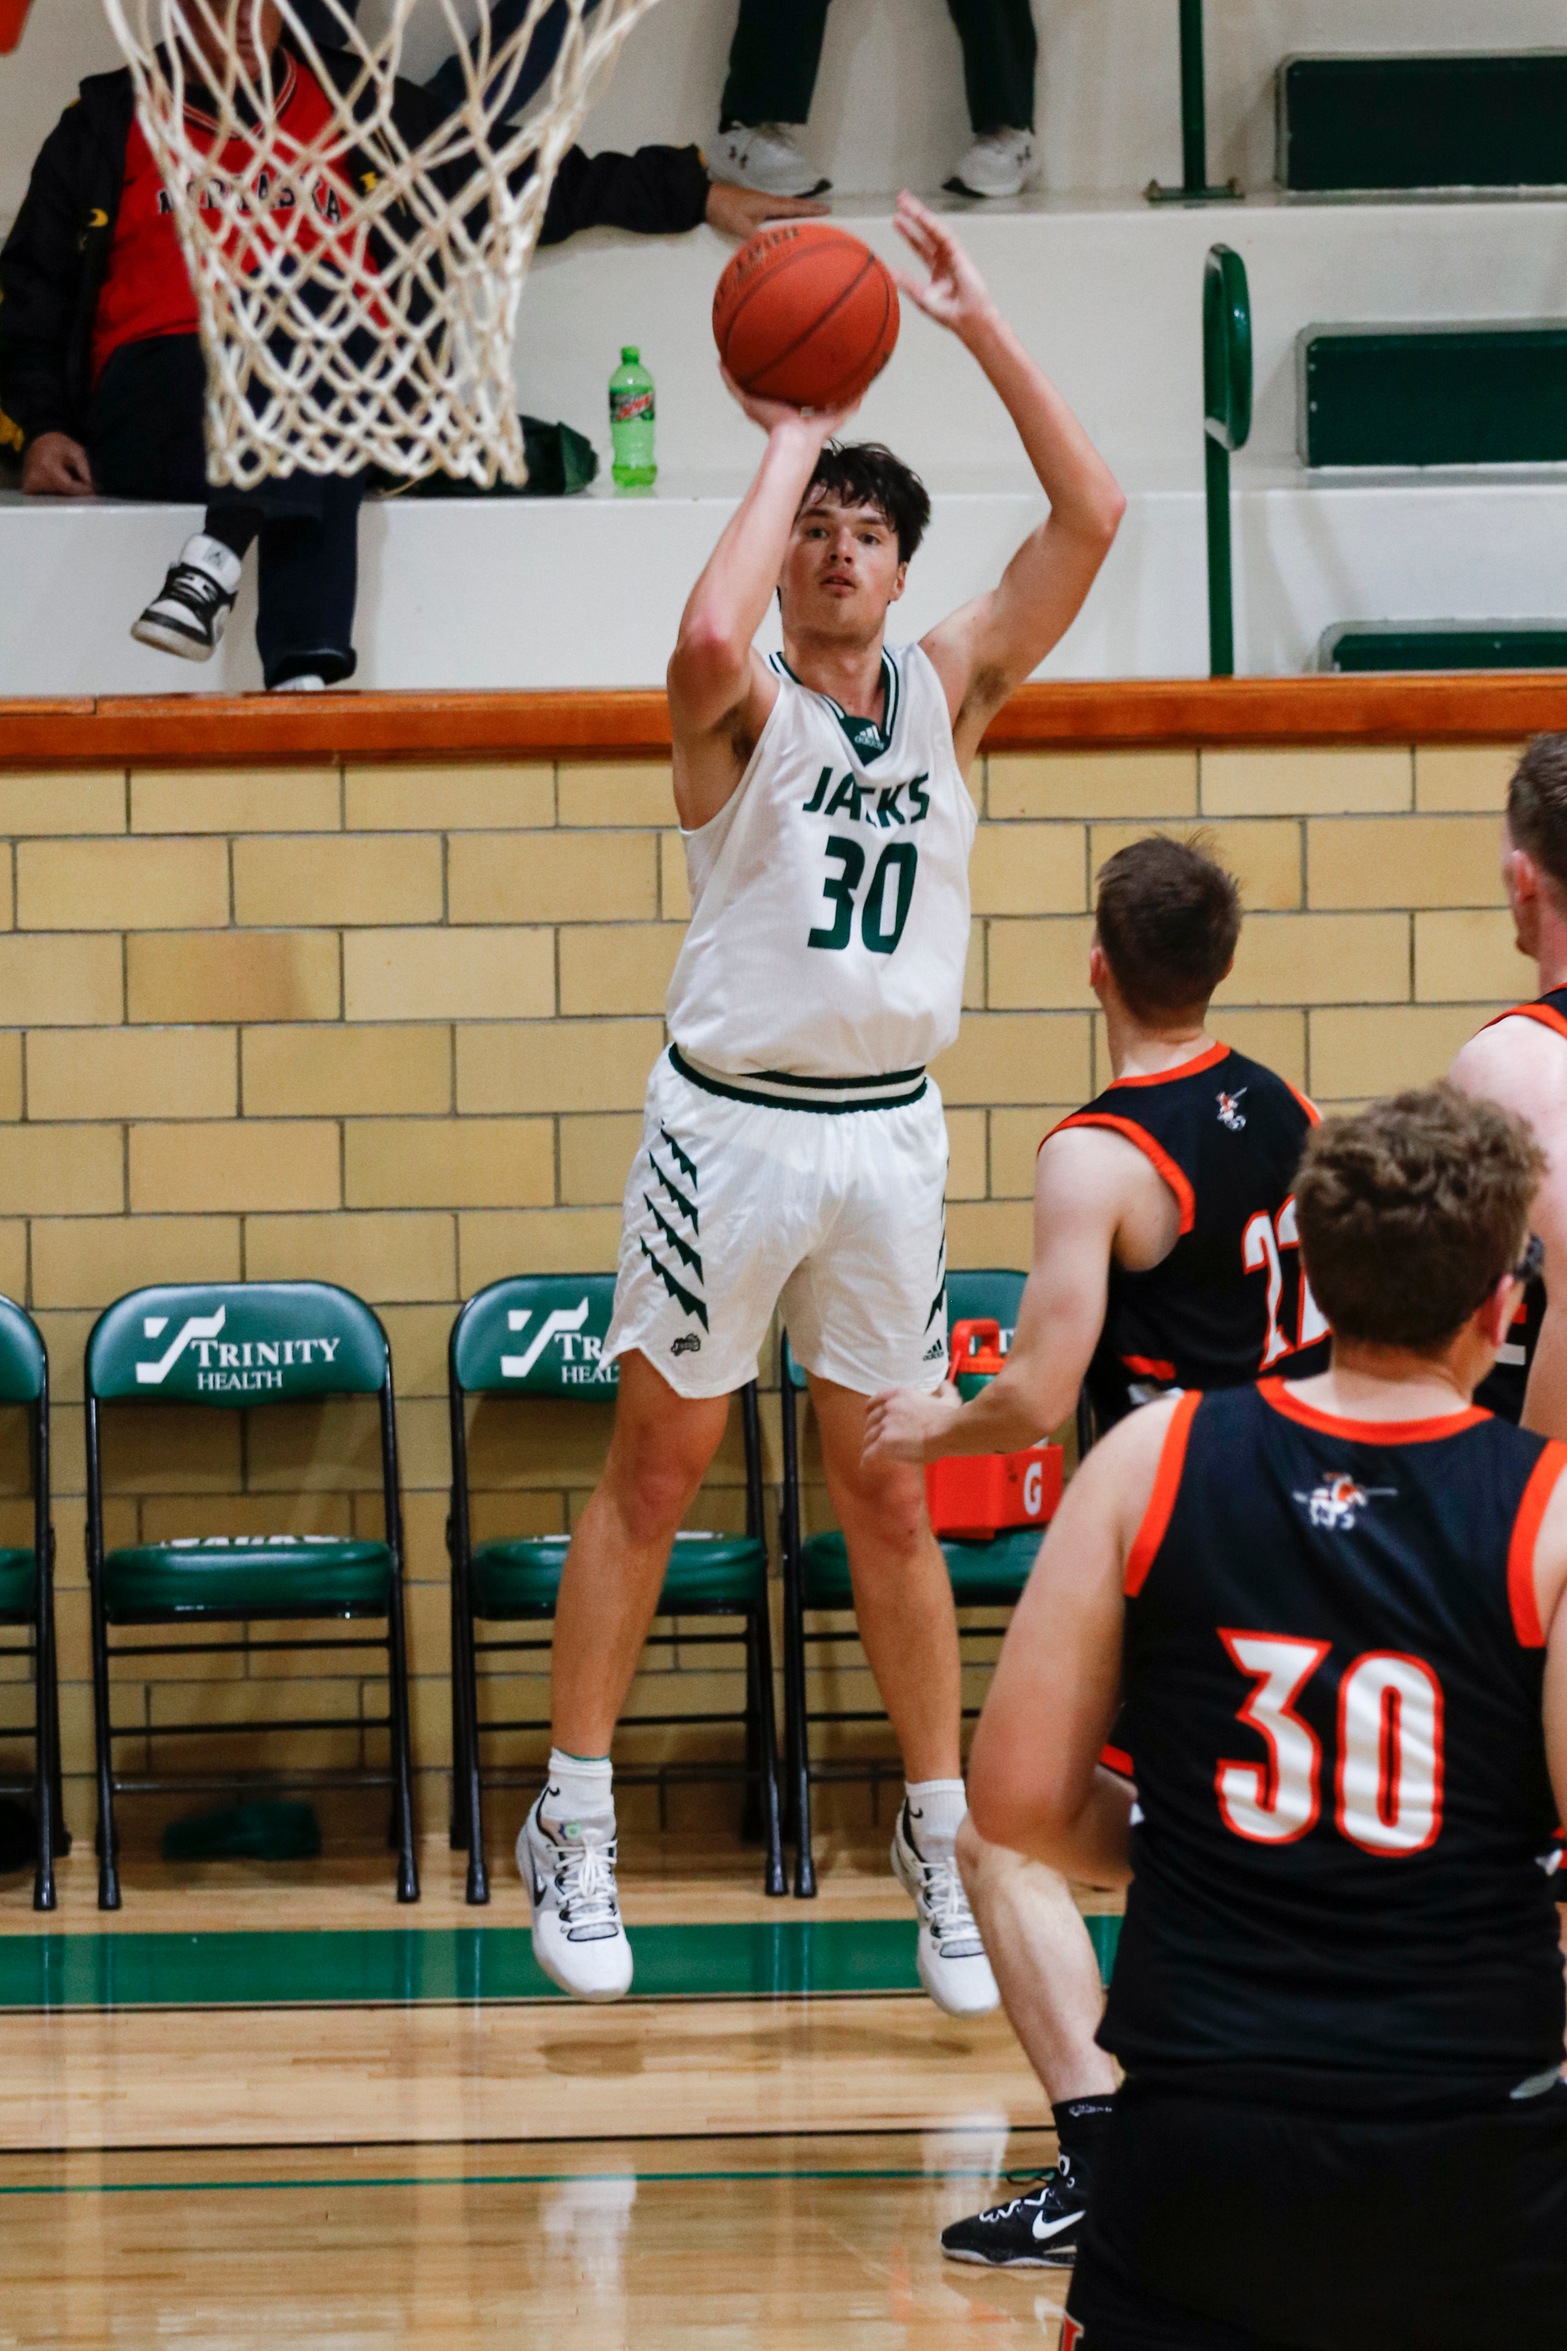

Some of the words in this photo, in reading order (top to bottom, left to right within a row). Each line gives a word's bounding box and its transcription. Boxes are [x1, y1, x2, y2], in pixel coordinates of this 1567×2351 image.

[807, 834, 918, 954] 30
[190, 1337, 340, 1368] TRINITY
[561, 1363, 620, 1384] HEAL
[196, 1370, 283, 1391] HEALTH
[1023, 1461, 1042, 1516] G
[1213, 1626, 1445, 1859] 30
